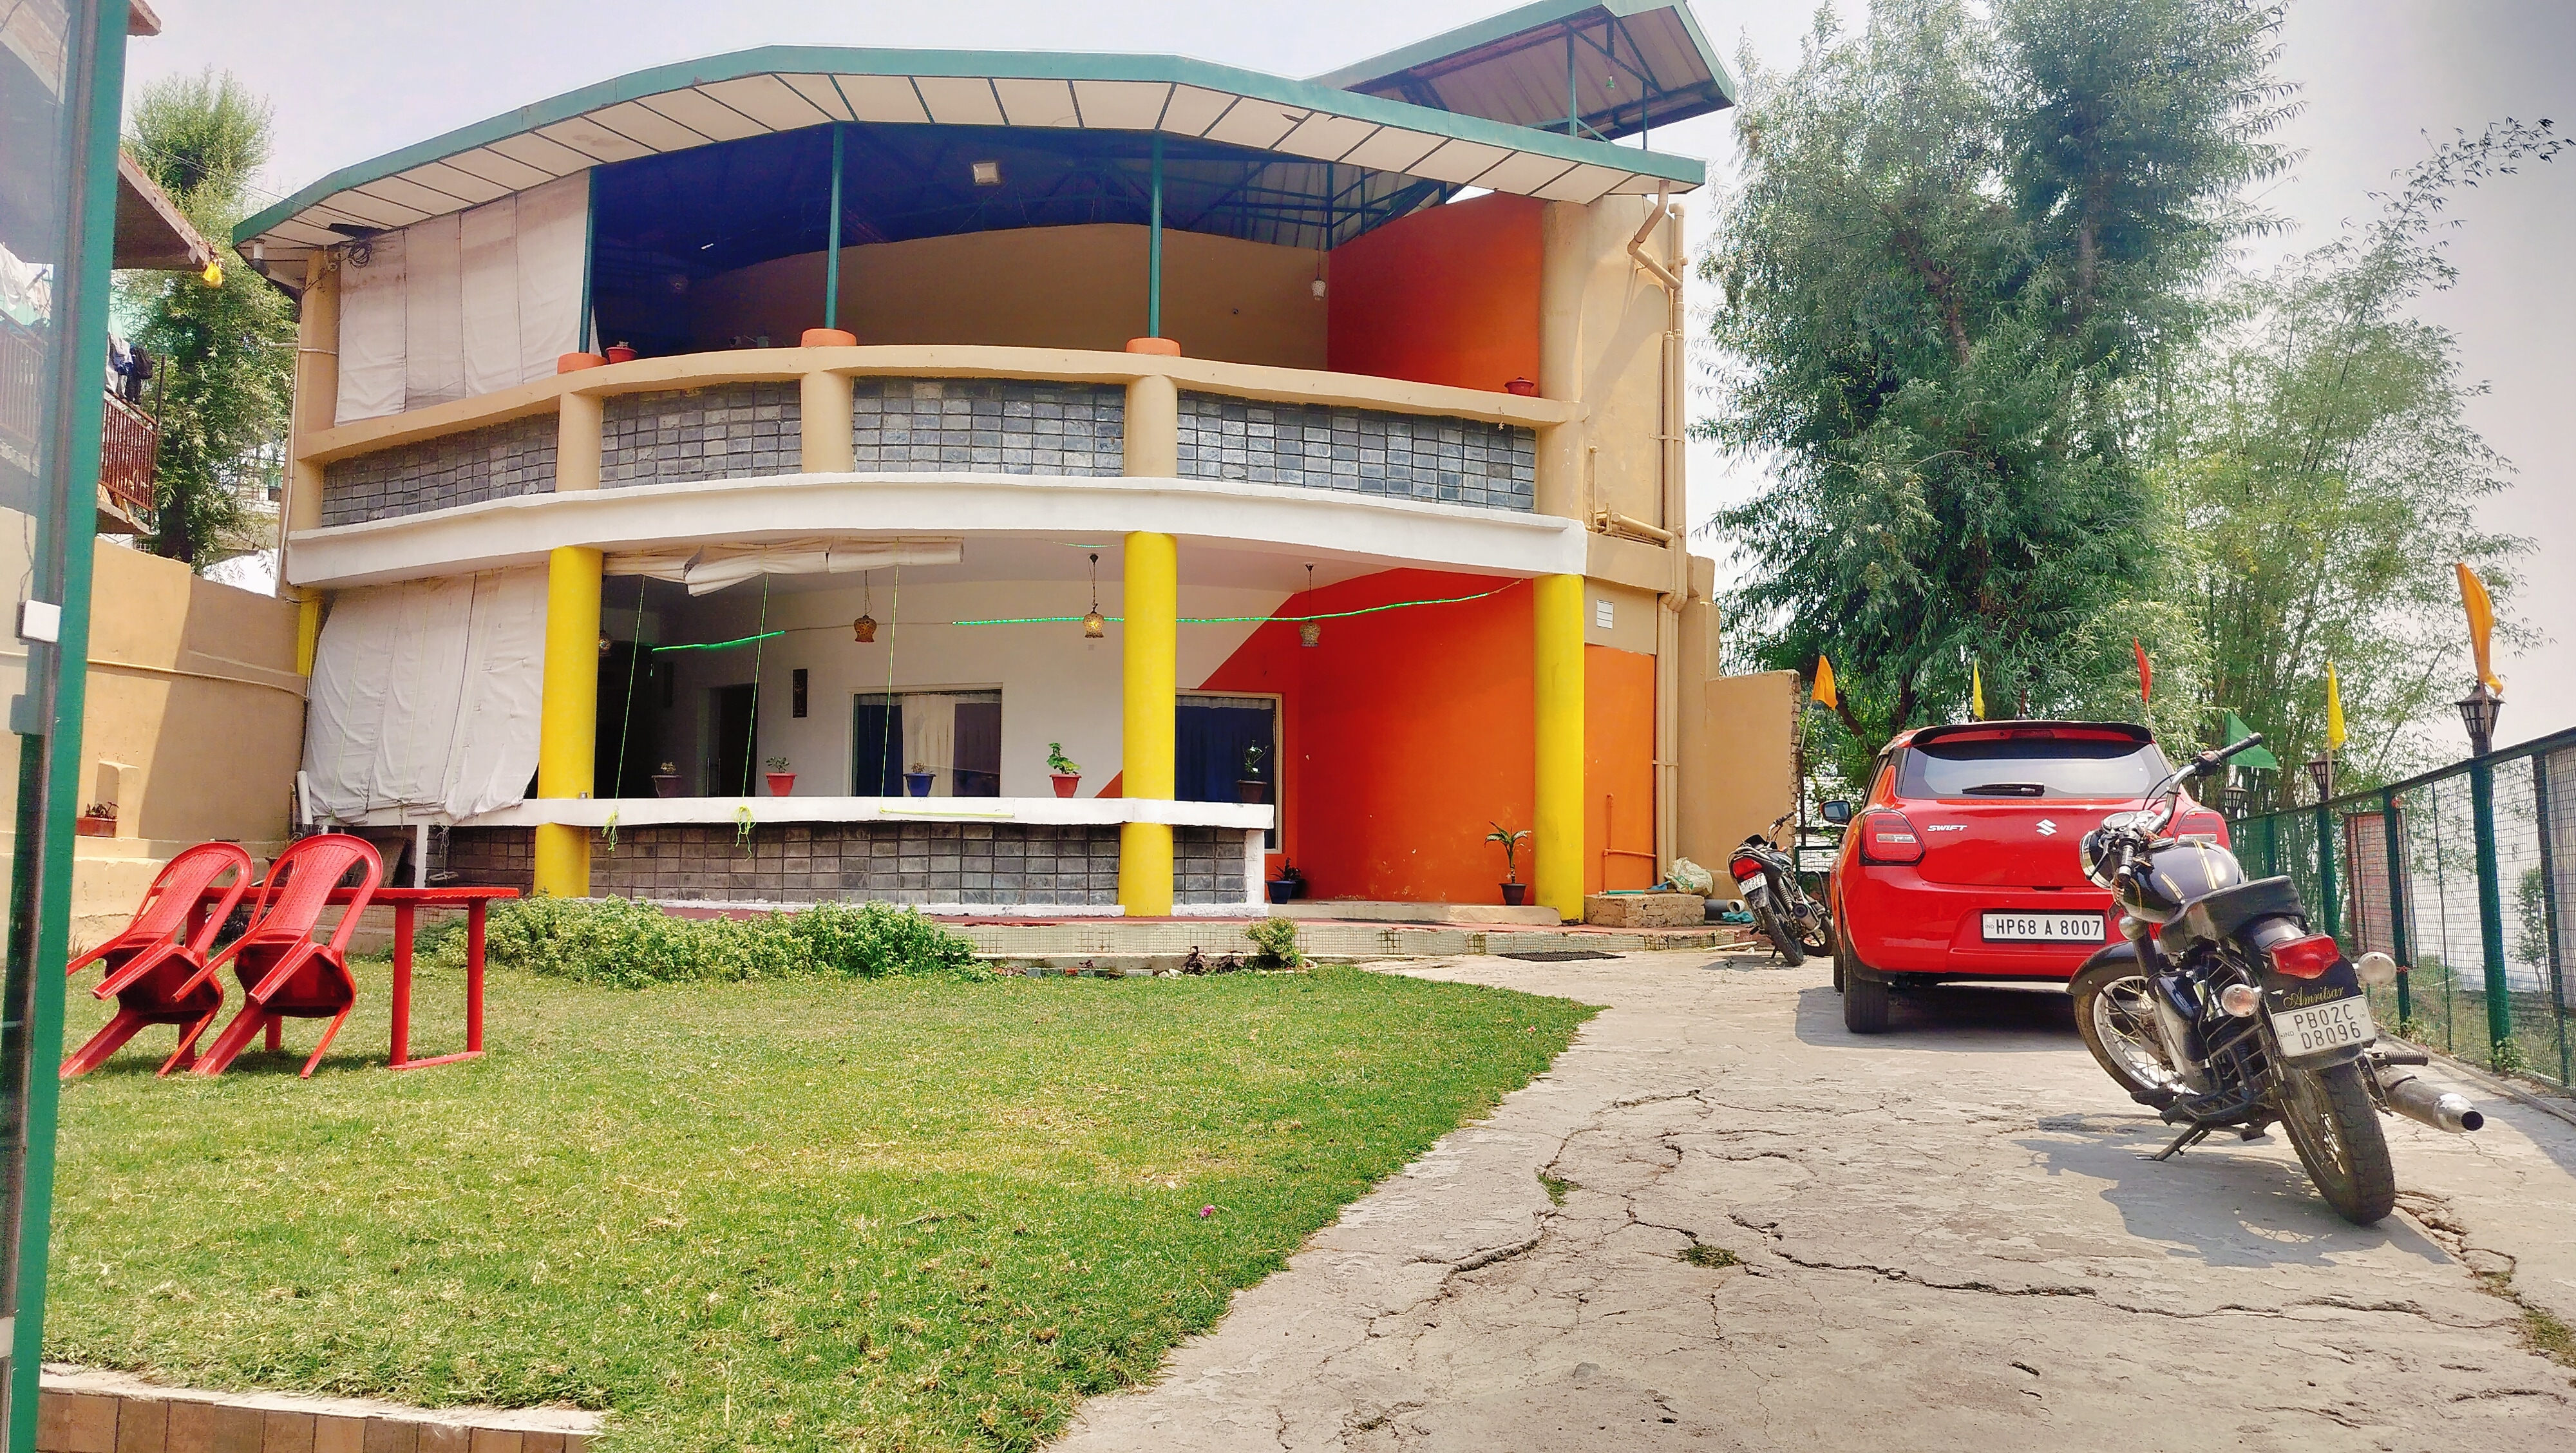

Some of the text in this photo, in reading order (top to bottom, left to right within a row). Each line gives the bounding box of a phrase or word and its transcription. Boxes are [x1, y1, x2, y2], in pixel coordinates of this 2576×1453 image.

[1996, 919, 2036, 935] HP68
[2045, 920, 2052, 935] A
[2061, 920, 2101, 936] 8007
[2283, 986, 2344, 1009] Amritsar
[2293, 1003, 2354, 1032] PB02C
[2300, 1021, 2361, 1050] D8096
